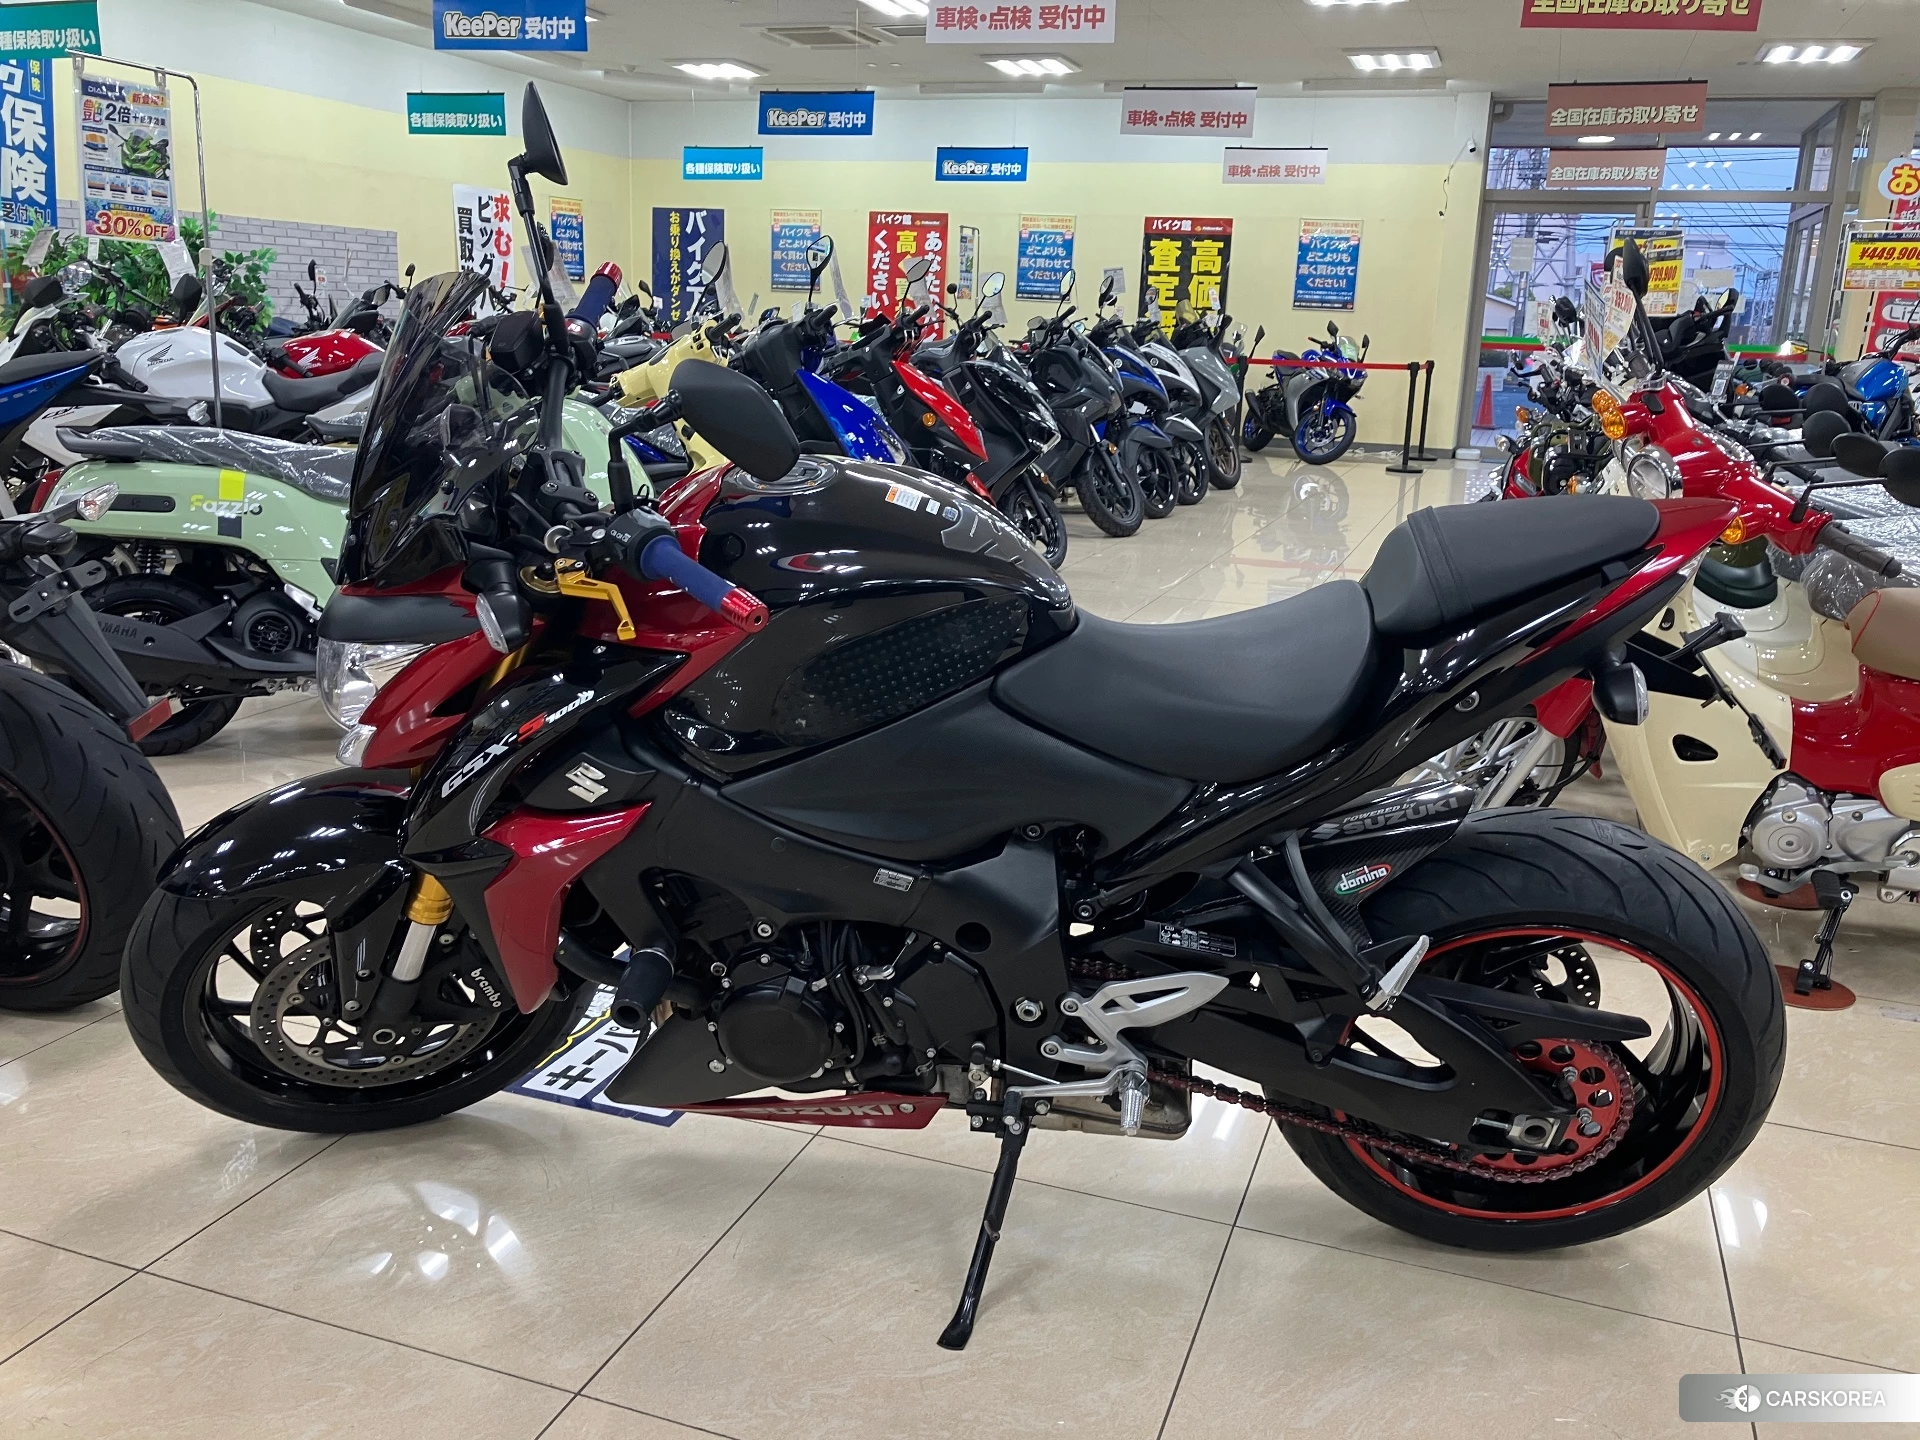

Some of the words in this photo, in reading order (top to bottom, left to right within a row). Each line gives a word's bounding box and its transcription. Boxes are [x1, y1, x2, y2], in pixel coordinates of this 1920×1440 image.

[444, 11, 521, 39] KeePer
[525, 16, 576, 40] 受付中
[935, 5, 1033, 31] 車検・点検
[1038, 5, 1105, 30] 受付中
[410, 113, 502, 129] 各種保険取り扱い
[767, 108, 827, 128] KeePer
[828, 111, 867, 128] 受付中
[1126, 110, 1196, 128] 車検・点検
[1200, 111, 1248, 129] 受付中
[1550, 105, 1699, 127] 全国在庫お取り寄せ
[685, 163, 760, 175] 各種保険取り扱い
[942, 160, 990, 176] KeePer
[991, 162, 1023, 176] 受付中
[1228, 164, 1281, 177] 車検・点検
[1284, 164, 1321, 178] 受付中
[1550, 166, 1660, 181] 全国在庫お取り寄せ
[1888, 164, 1920, 195] お
[494, 194, 512, 288] 求む!
[871, 229, 891, 315] ください
[190, 494, 263, 516] Fazzio
[1342, 797, 1459, 835] SUZUKI
[1343, 805, 1400, 823] POWERED
[1340, 865, 1387, 891] domino
[470, 967, 503, 1008] brembo
